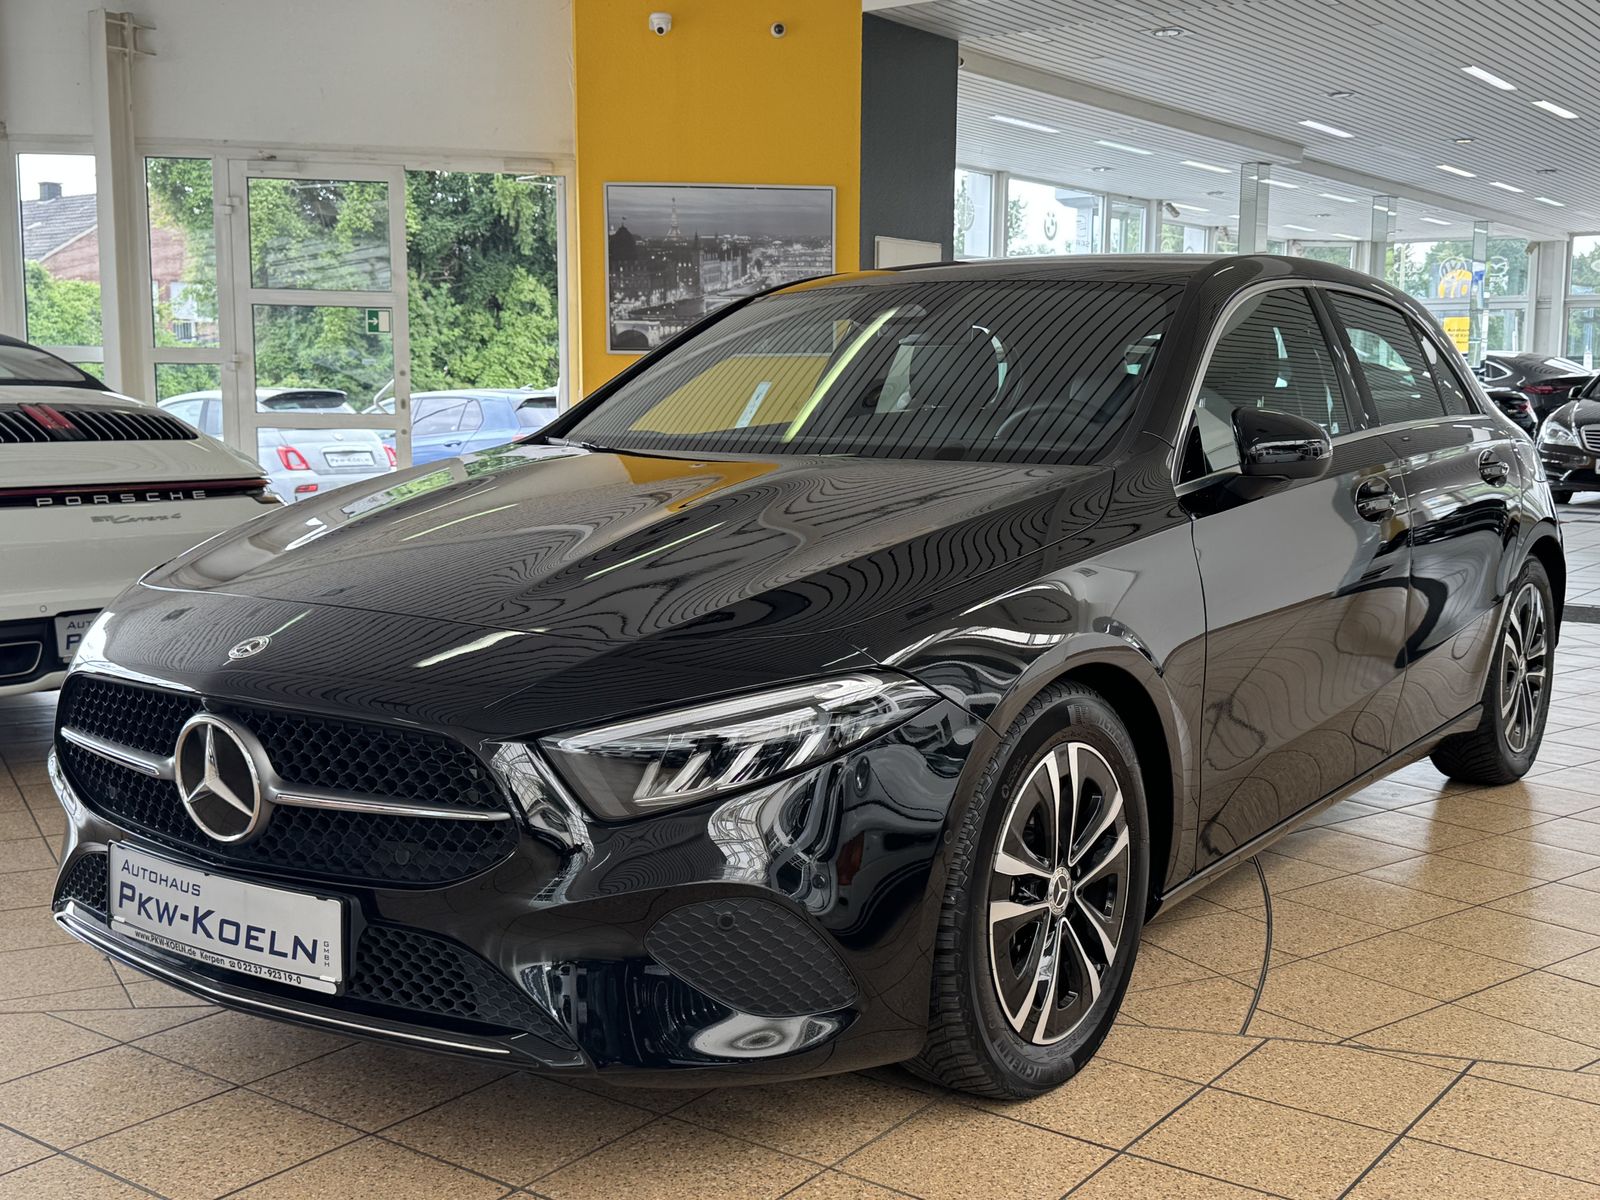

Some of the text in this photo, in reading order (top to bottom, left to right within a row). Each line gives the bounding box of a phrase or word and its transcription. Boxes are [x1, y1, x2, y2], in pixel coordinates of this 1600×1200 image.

[36, 490, 206, 507] PORSCHE
[121, 859, 201, 897] AUTOHAUS
[118, 880, 318, 964] PKW-KOELN
[200, 951, 226, 966] Kerpen
